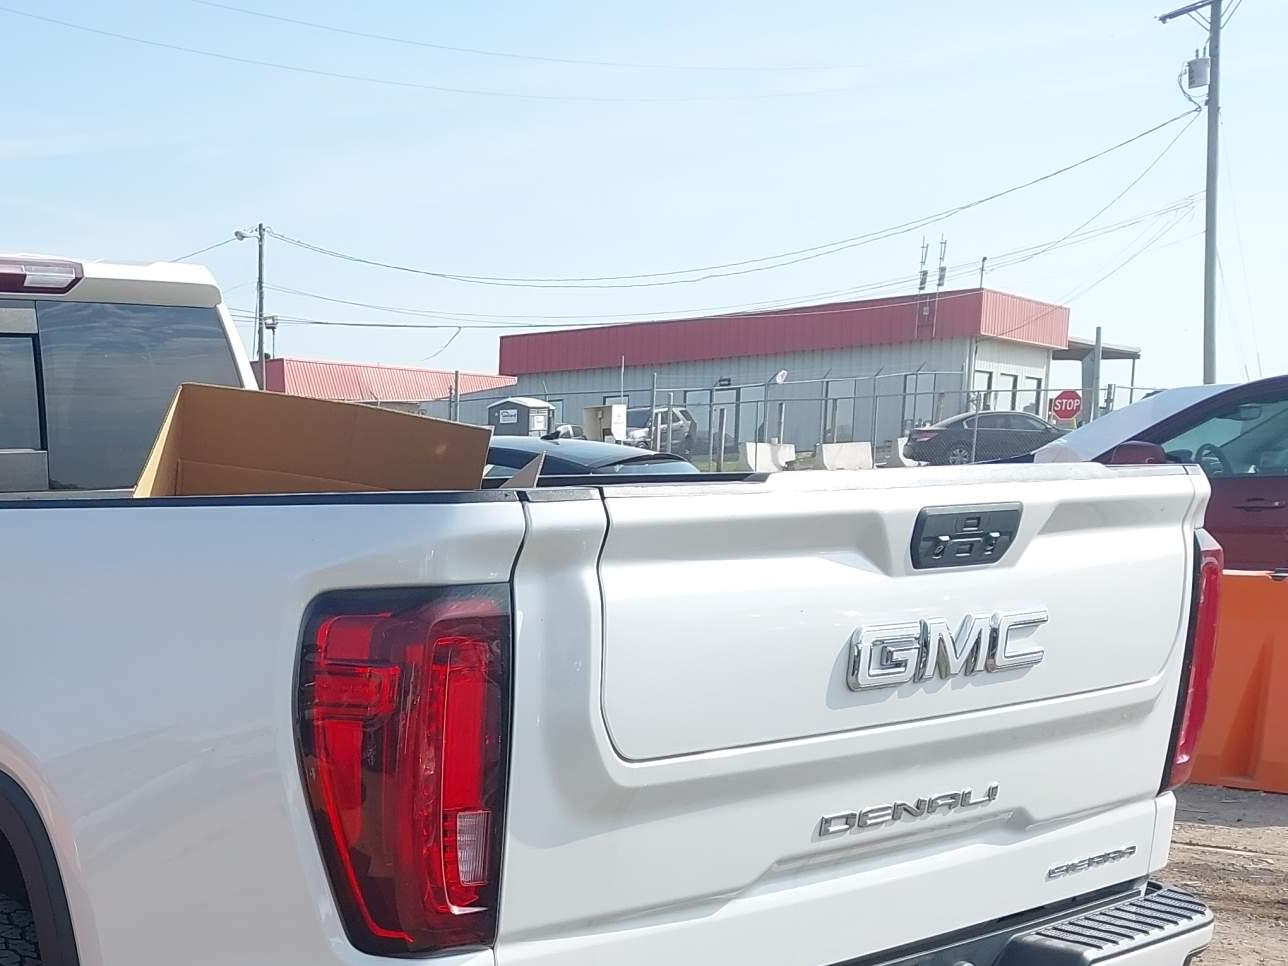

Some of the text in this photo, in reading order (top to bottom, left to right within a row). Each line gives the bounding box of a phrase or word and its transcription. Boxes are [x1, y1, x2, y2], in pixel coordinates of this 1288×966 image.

[1054, 399, 1081, 411] STOP
[846, 607, 1049, 692] GMC
[819, 781, 999, 837] DENALI
[1048, 845, 1137, 879] SIERRA
